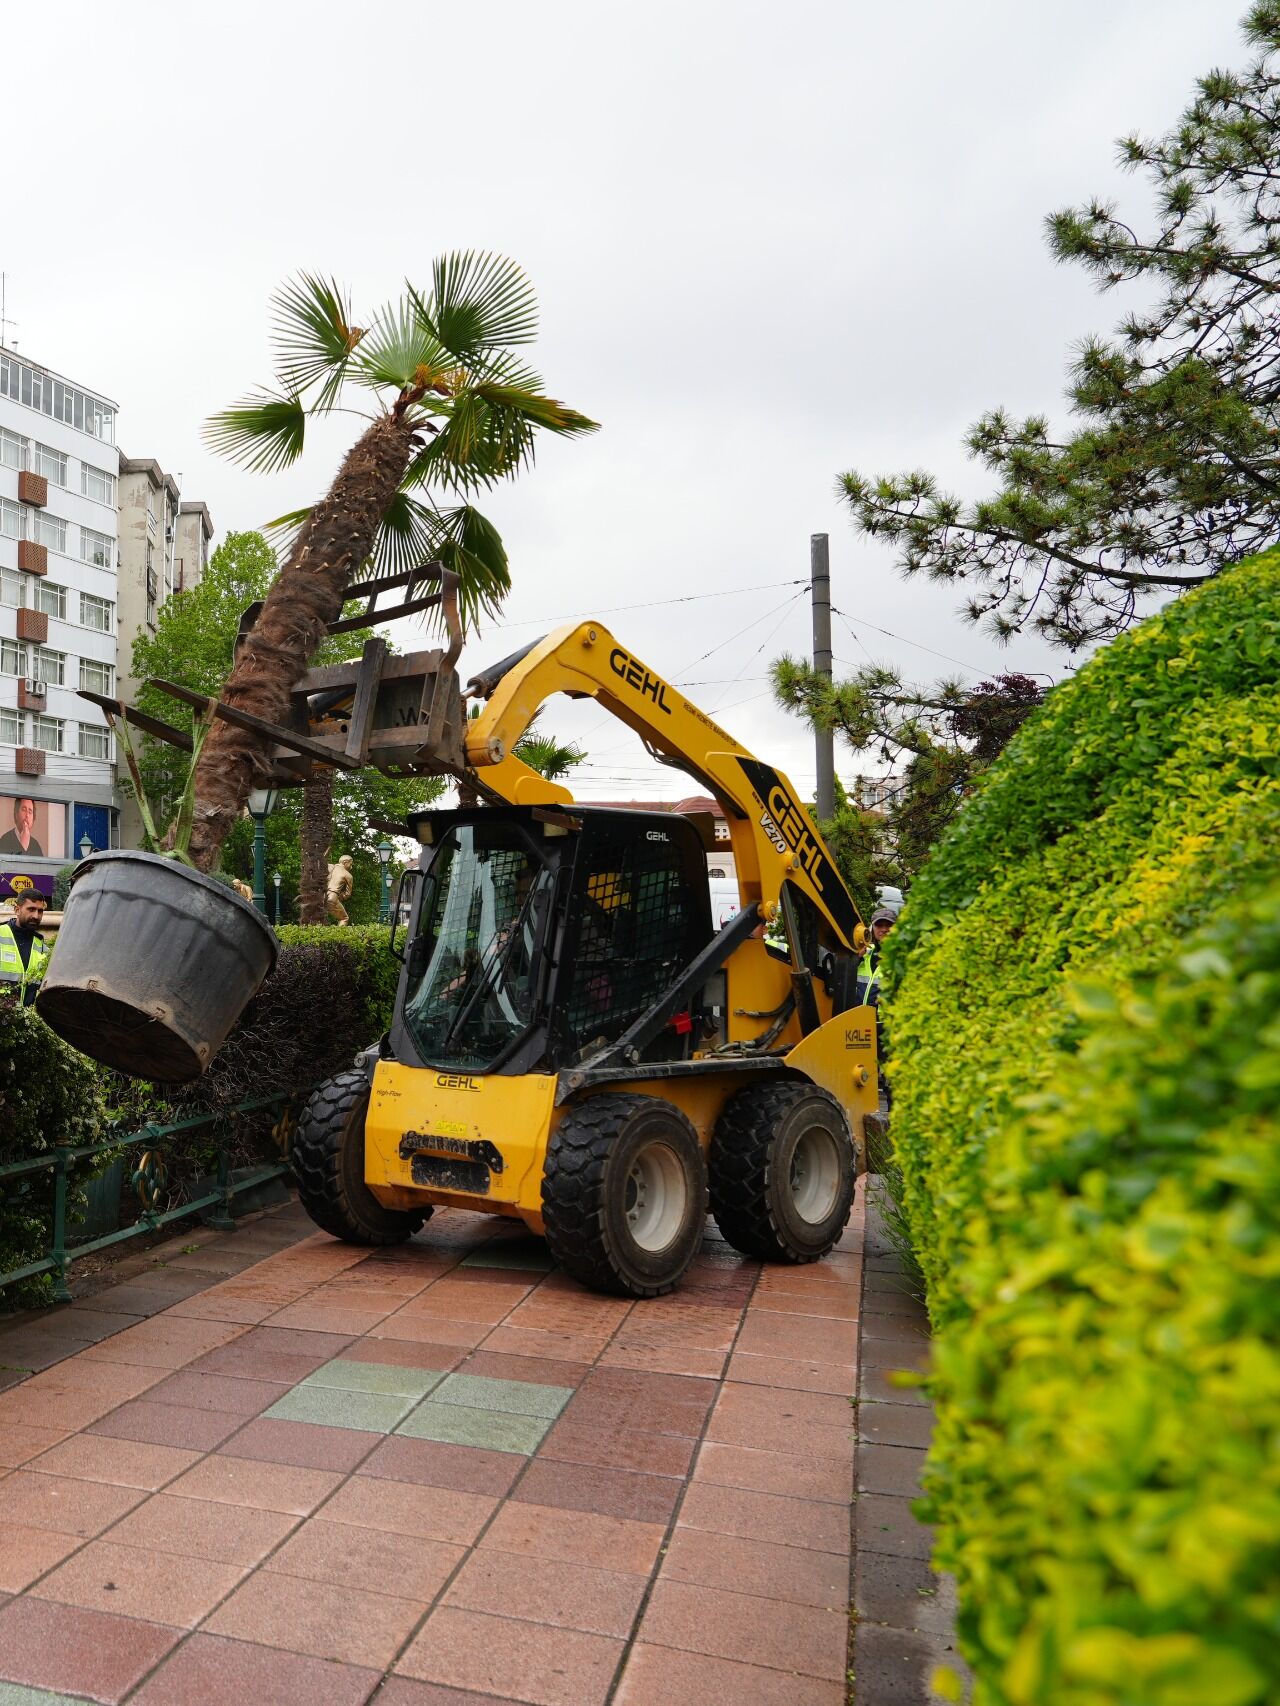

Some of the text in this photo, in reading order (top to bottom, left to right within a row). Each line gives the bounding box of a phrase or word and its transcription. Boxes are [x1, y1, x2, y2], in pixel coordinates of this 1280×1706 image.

[610, 648, 672, 715] GEHL
[645, 830, 670, 842] GEHL
[759, 811, 787, 854] V270
[768, 785, 823, 892] GEHL
[845, 1029, 872, 1042] KALE
[436, 1073, 479, 1090] GEHL
